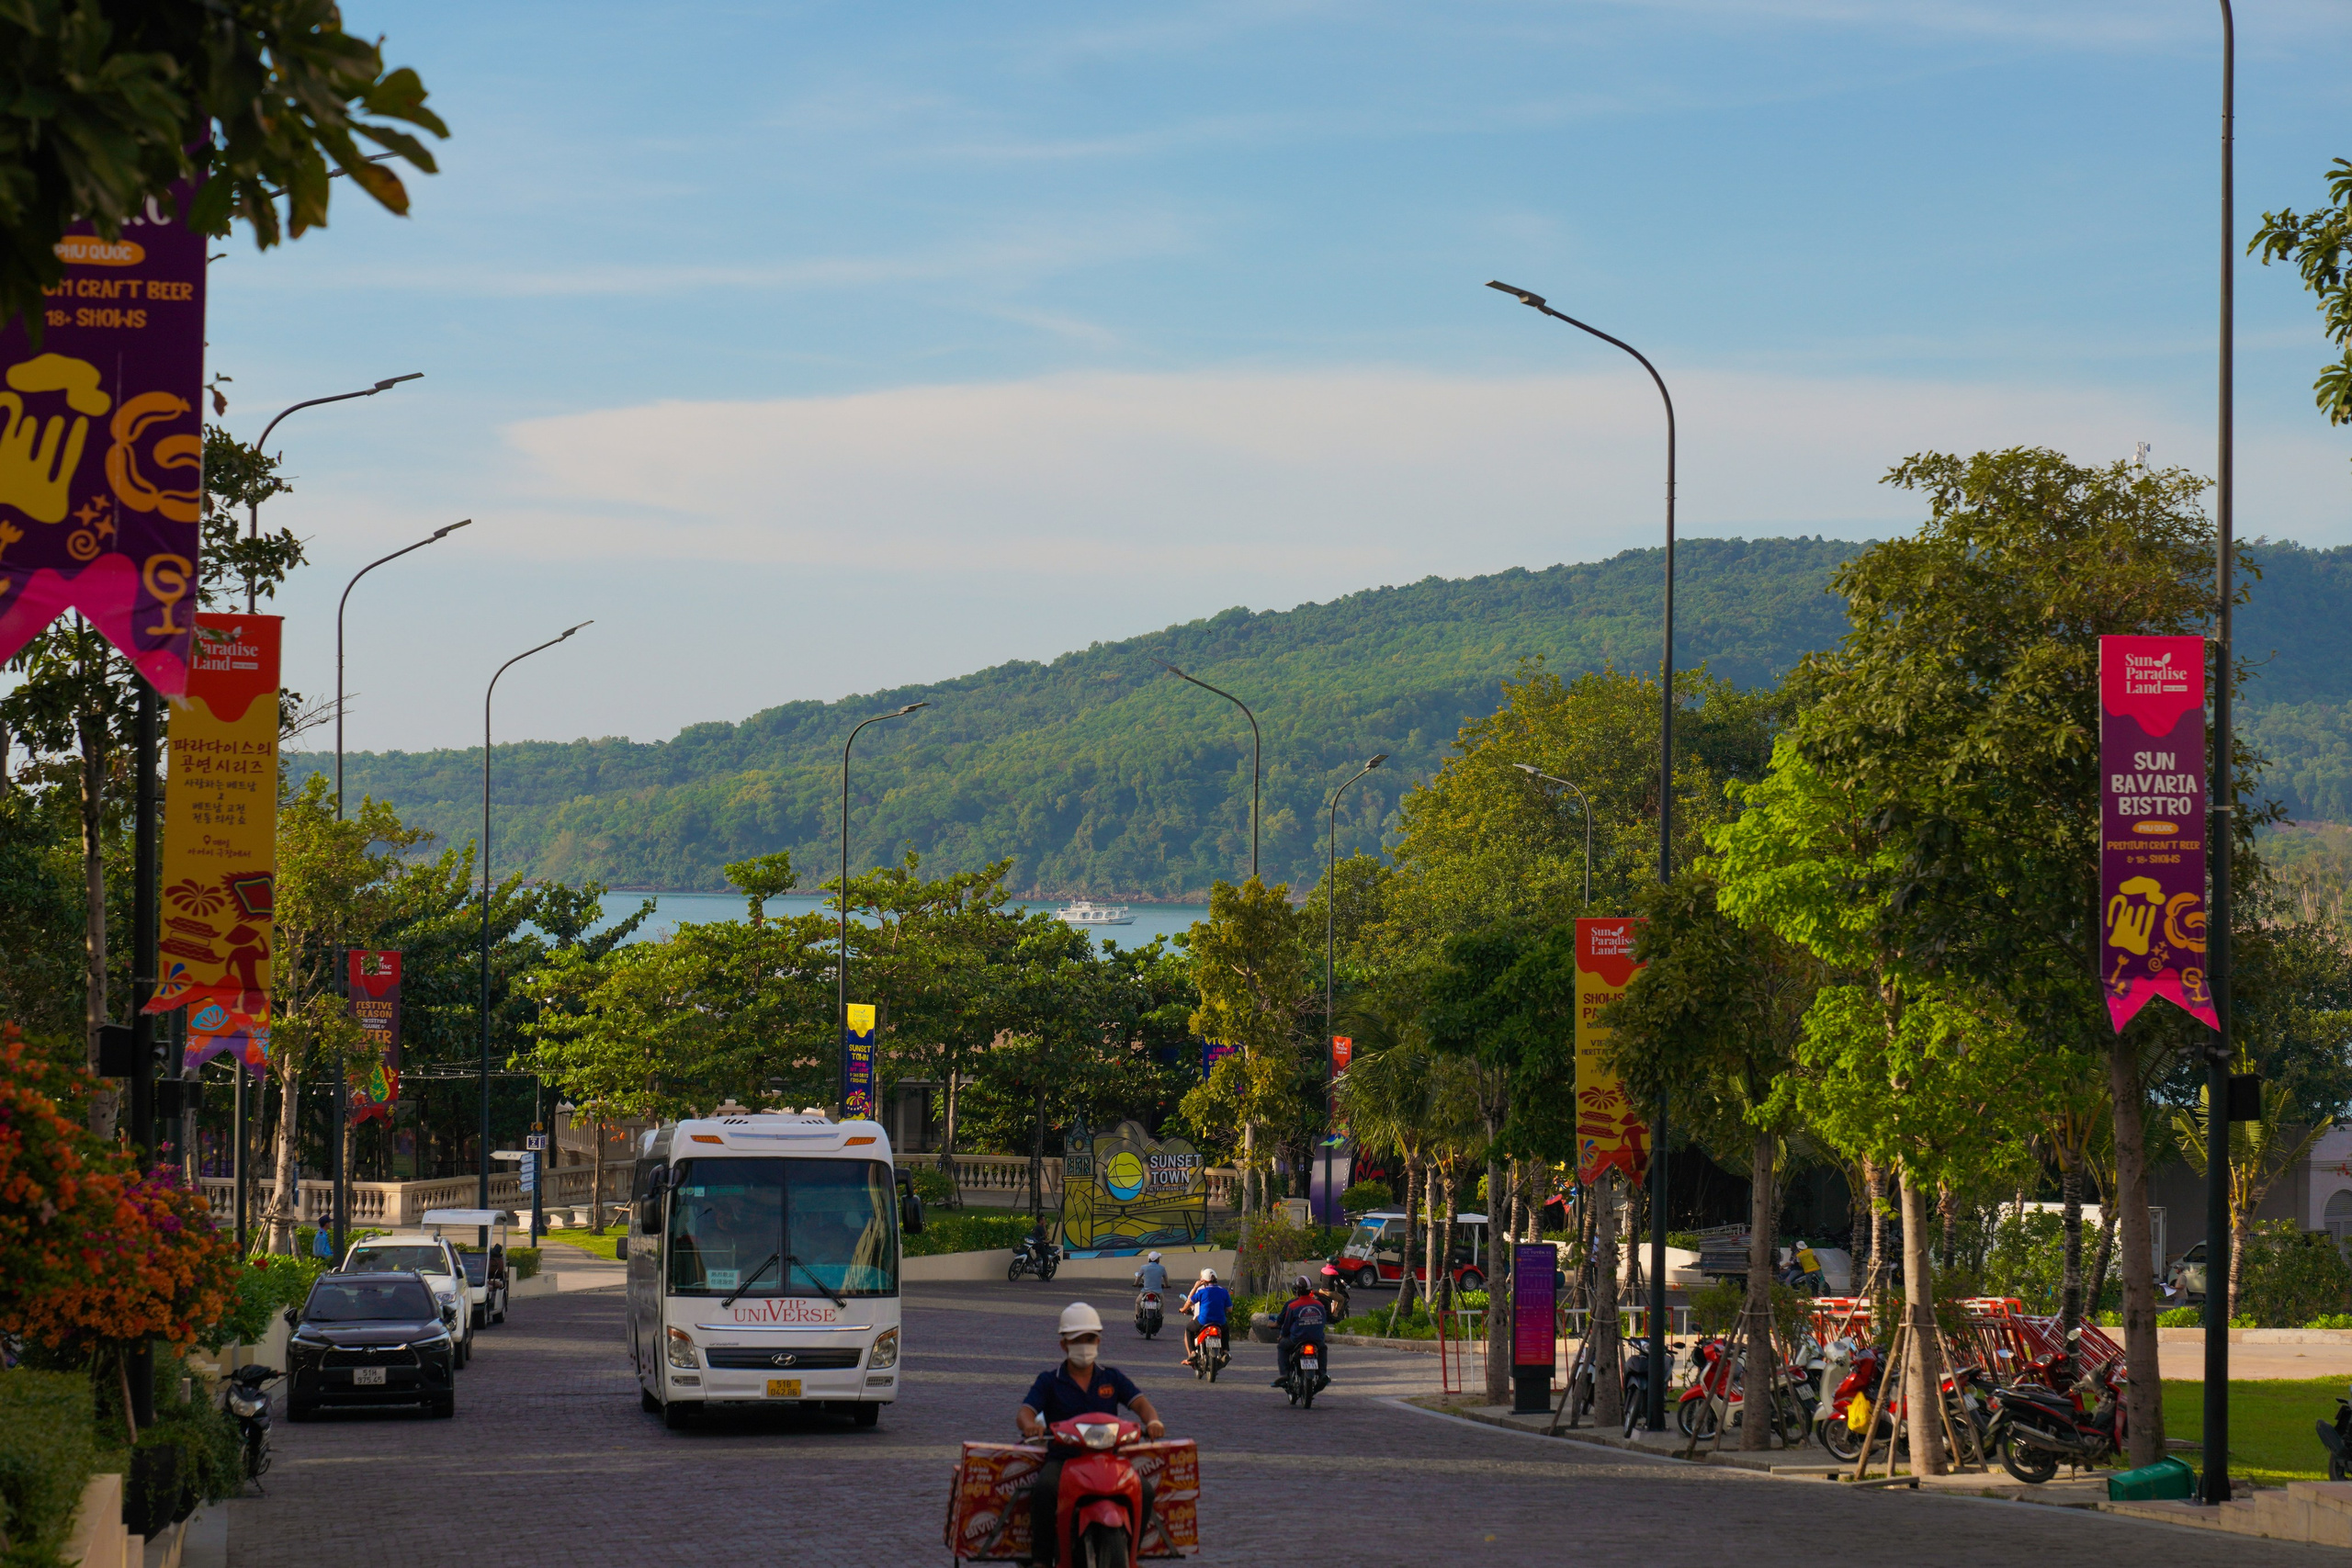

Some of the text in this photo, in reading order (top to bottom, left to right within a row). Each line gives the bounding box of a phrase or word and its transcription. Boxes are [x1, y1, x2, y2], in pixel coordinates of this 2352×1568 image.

[76, 278, 143, 299] CRAFT
[147, 280, 193, 301] BEER
[45, 307, 147, 328] 18+ SHOWS
[193, 655, 231, 671] Land
[2125, 653, 2154, 667] Sun
[2125, 666, 2188, 681] Paradise
[2126, 680, 2162, 694] Land
[173, 738, 271, 756] 파라다이스의
[180, 755, 264, 773] 공연 시리즈
[2133, 751, 2176, 771] SUN
[227, 781, 257, 792] 베트남
[2111, 773, 2198, 794] BAVARIA
[192, 802, 223, 813] 베트남
[2119, 796, 2191, 816] BISTRO
[2107, 840, 2200, 851] PREMIUM CRAFT BEER
[2149, 854, 2180, 863] SHOWS
[1590, 927, 1611, 937] Sun
[1591, 936, 1634, 946] Paradis
[1591, 945, 1617, 955] Land
[356, 1000, 392, 1010] FESTIVE
[356, 1010, 392, 1019] SEASON
[849, 1043, 872, 1053] SUNSET
[852, 1053, 869, 1061] TOWN
[1149, 1154, 1202, 1168] SUNSET
[1151, 1170, 1190, 1185] TOWN
[735, 1304, 837, 1322] UNIVERSE
